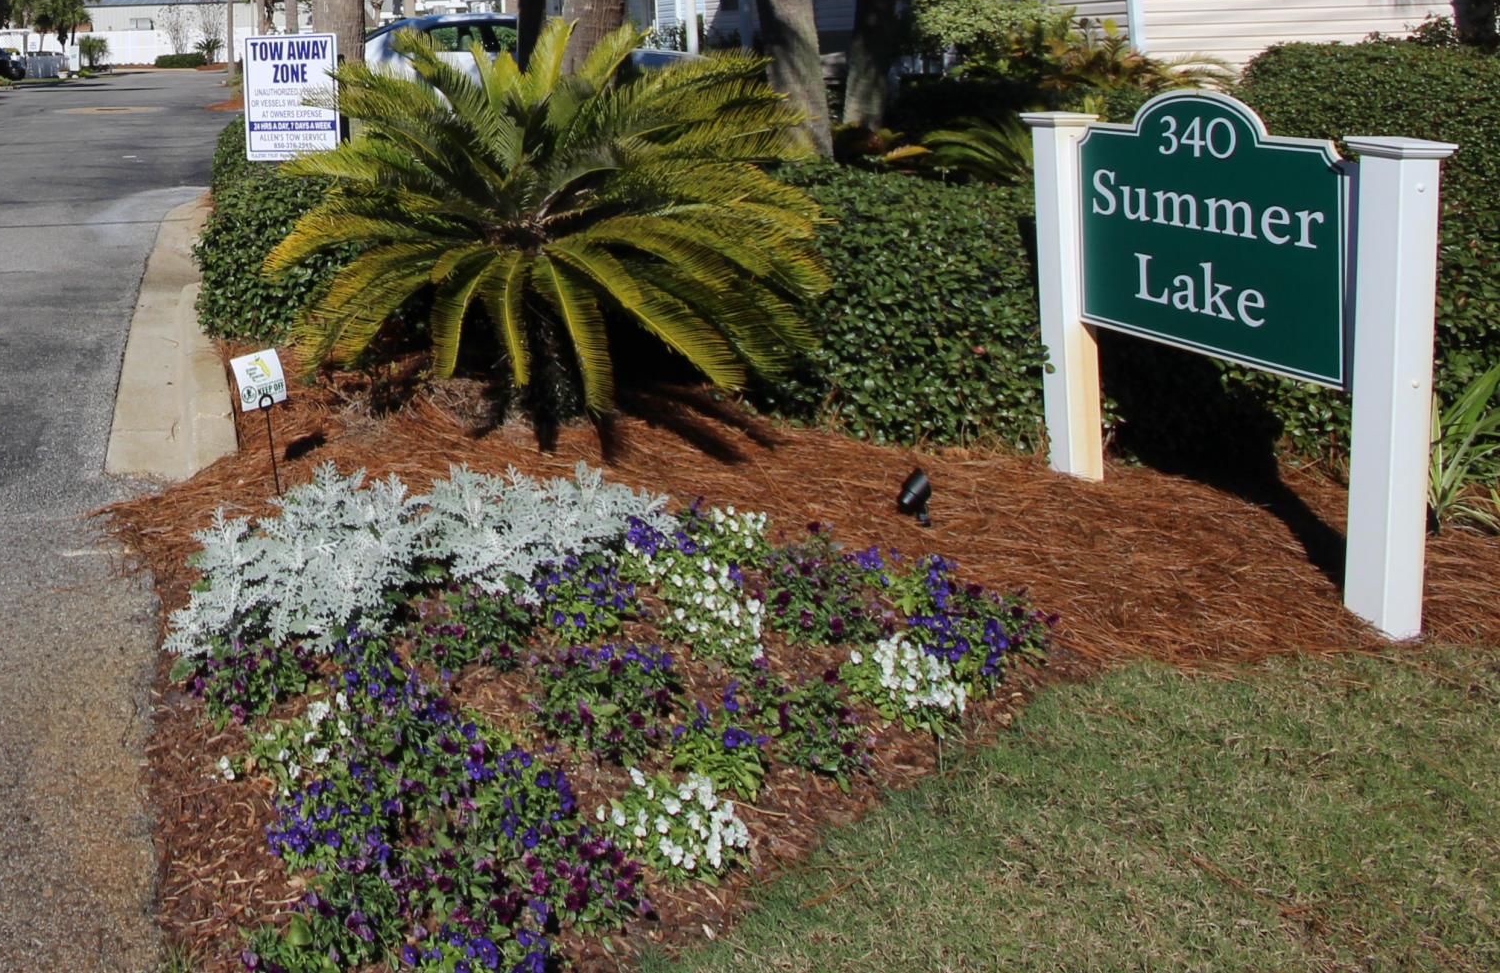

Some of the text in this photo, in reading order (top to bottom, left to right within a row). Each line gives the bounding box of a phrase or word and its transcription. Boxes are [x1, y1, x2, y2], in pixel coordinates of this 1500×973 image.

[250, 40, 328, 61] TOW AWAY
[273, 63, 308, 83] ZONE
[254, 88, 298, 96] UNAUTHORIZED
[261, 99, 285, 107] VESSELS
[262, 109, 323, 118] AT OWNERS EXPENSE
[260, 133, 283, 141] ALLEN'S
[302, 132, 327, 141] SERVICE
[1158, 115, 1237, 159] 340
[1092, 168, 1325, 250] Summer
[1133, 252, 1266, 328] Lake
[257, 385, 273, 396] KEEP
[273, 382, 284, 391] OFF
